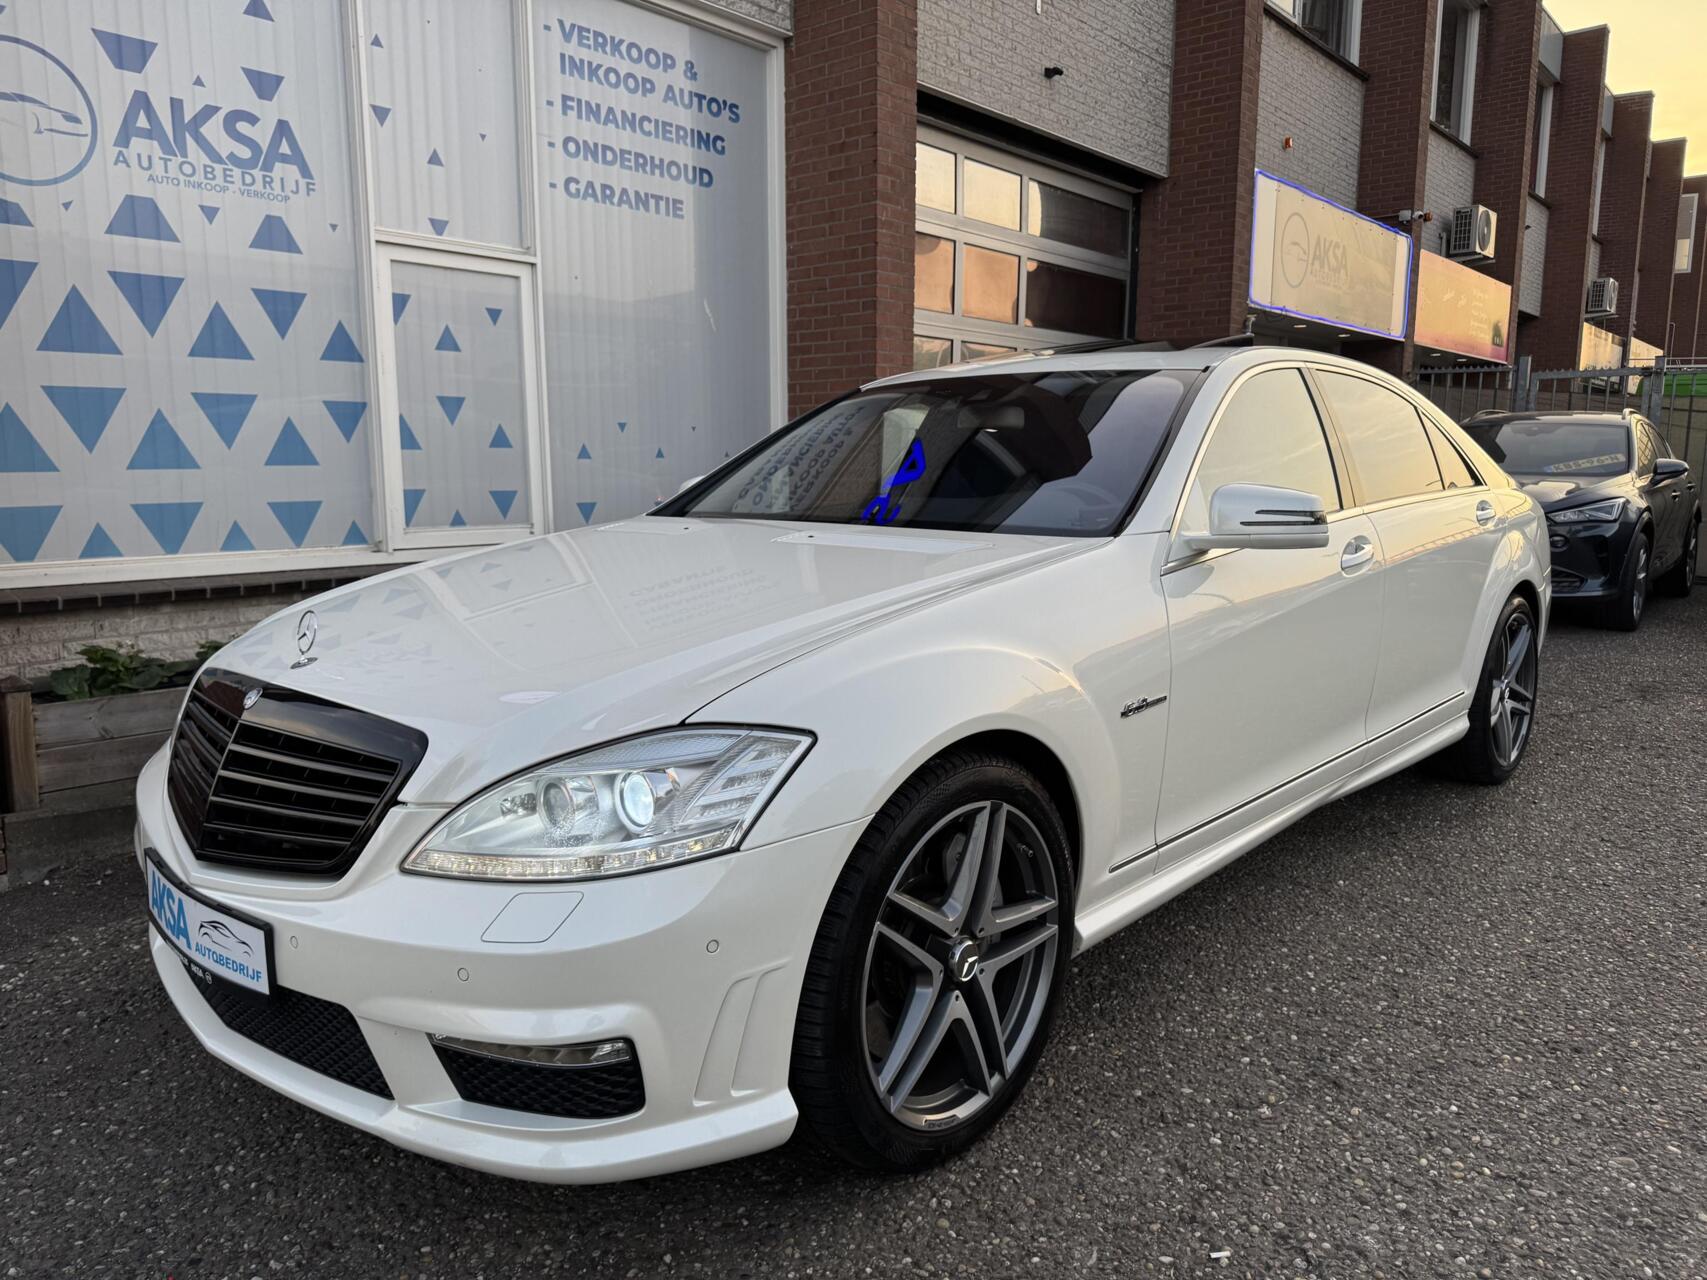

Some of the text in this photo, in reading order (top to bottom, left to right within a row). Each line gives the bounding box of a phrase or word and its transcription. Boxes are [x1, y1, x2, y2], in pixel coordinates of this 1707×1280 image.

[557, 18, 676, 74] VERKOOP
[683, 60, 698, 82] &
[559, 53, 741, 124] INKOOP AUTO'S
[112, 89, 315, 181] AKSA
[560, 94, 726, 156] FINANCIERING
[113, 150, 317, 197] AUTOBEDRIJF
[147, 173, 180, 187] AUTO
[184, 180, 230, 194] INKOOP
[239, 188, 290, 204] VERKOOP
[562, 136, 714, 189] ONDERHOUD
[563, 176, 685, 220] GARANTIE
[1311, 234, 1348, 277] AKSA
[151, 870, 192, 950] AKSA
[195, 942, 262, 982] AUTOBEDRIJF
